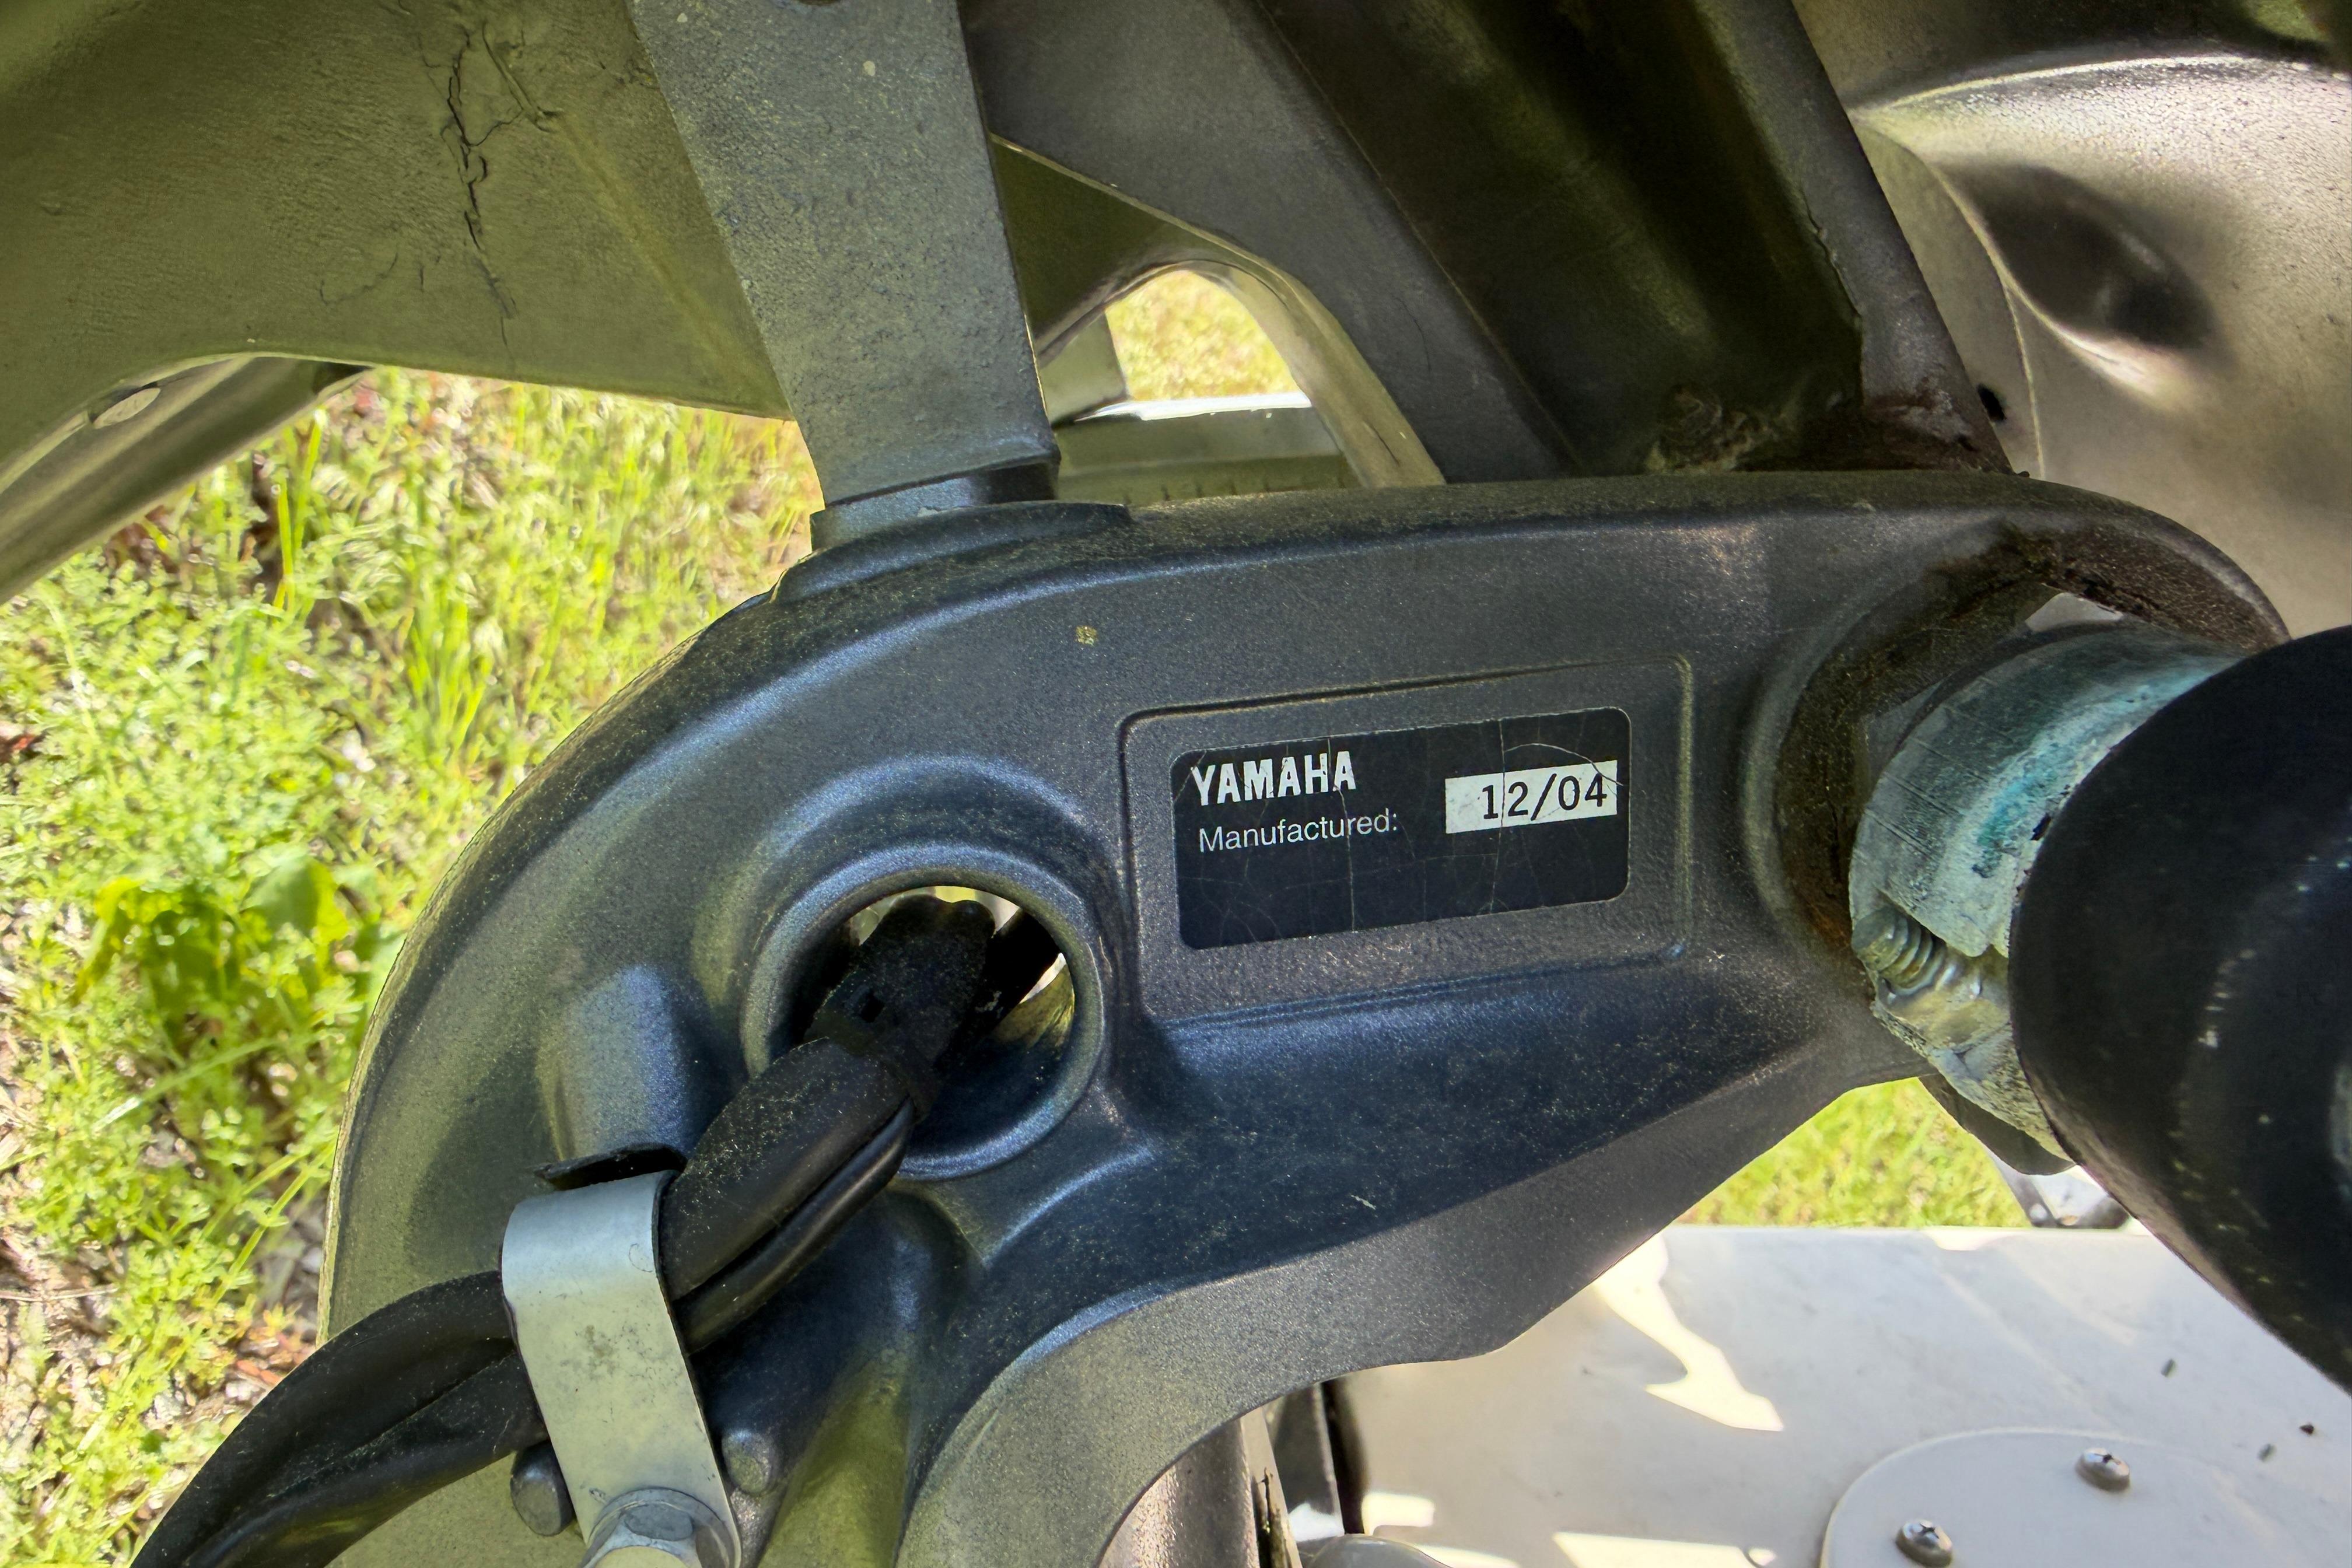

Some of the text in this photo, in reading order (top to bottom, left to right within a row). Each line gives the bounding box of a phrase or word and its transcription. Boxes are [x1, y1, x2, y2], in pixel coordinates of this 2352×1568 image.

[1192, 751, 1356, 806] YAMAHA
[1200, 773, 1608, 852] Manufactured: 12/04
